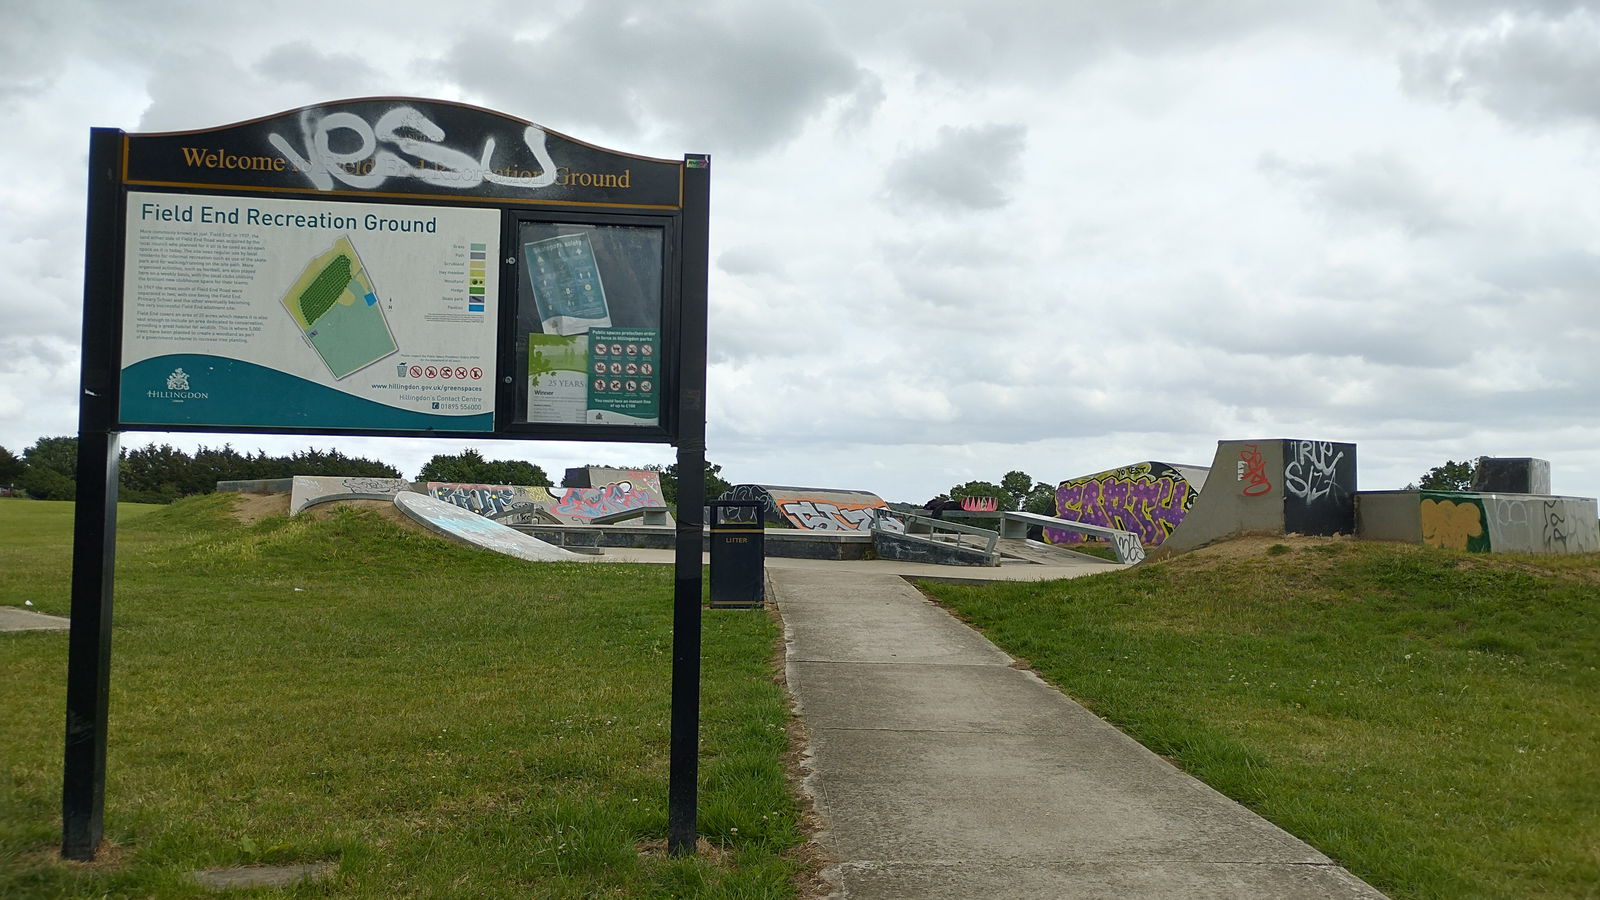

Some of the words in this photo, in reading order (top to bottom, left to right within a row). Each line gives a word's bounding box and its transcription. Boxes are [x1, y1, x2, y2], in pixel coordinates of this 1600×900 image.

[181, 146, 287, 172] Welcome
[554, 166, 631, 188] Ground
[142, 203, 192, 222] Field
[201, 206, 239, 224] End
[247, 208, 357, 230] Recreation
[364, 213, 437, 234] Ground
[146, 390, 208, 399] HILLINGDON
[372, 384, 482, 392] www.hillingdon.gov.uk/greenspaces
